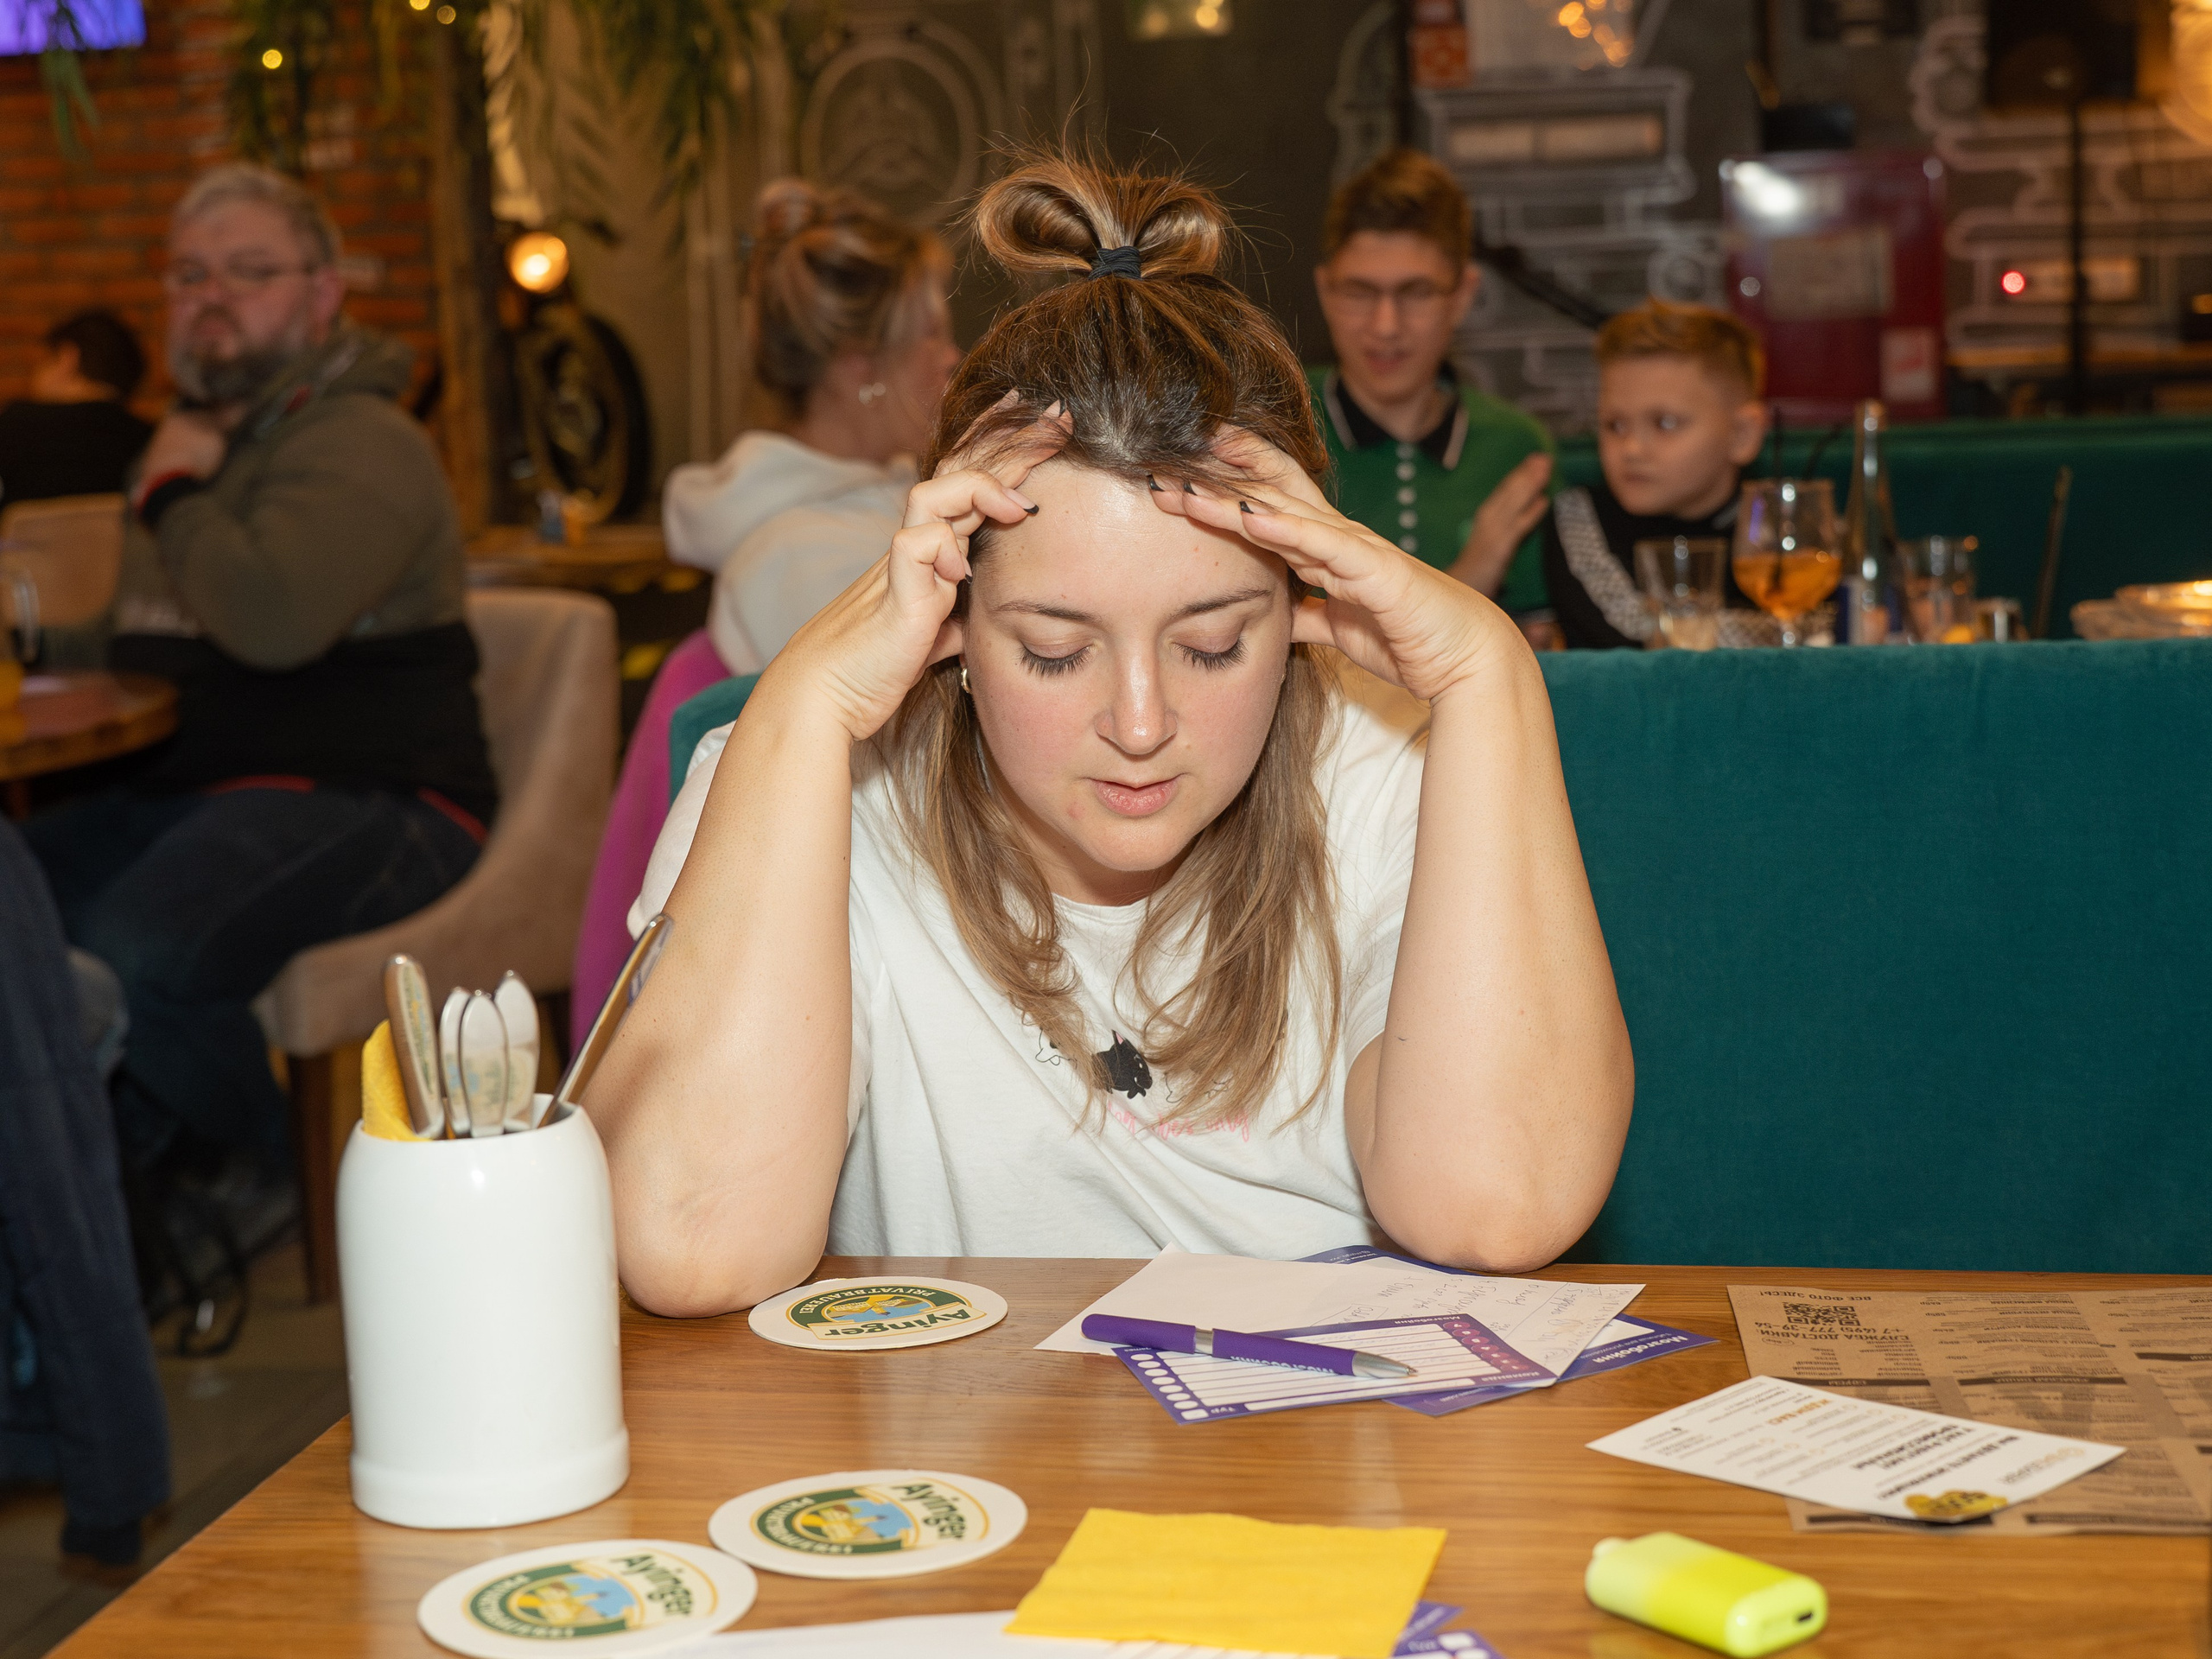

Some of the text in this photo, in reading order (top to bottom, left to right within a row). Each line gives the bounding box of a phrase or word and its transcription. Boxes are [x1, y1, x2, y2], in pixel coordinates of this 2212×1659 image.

[798, 1287, 936, 1313] PRIVATBRAUEREI
[824, 1309, 971, 1336] Ayinger
[1394, 1315, 1460, 1325] Мозгобойня
[1755, 1322, 1835, 1332] 777-39-54
[1592, 1335, 1688, 1363] Мозгобойня
[892, 1484, 966, 1541] Ayinger
[610, 1554, 693, 1617] Ayinger
